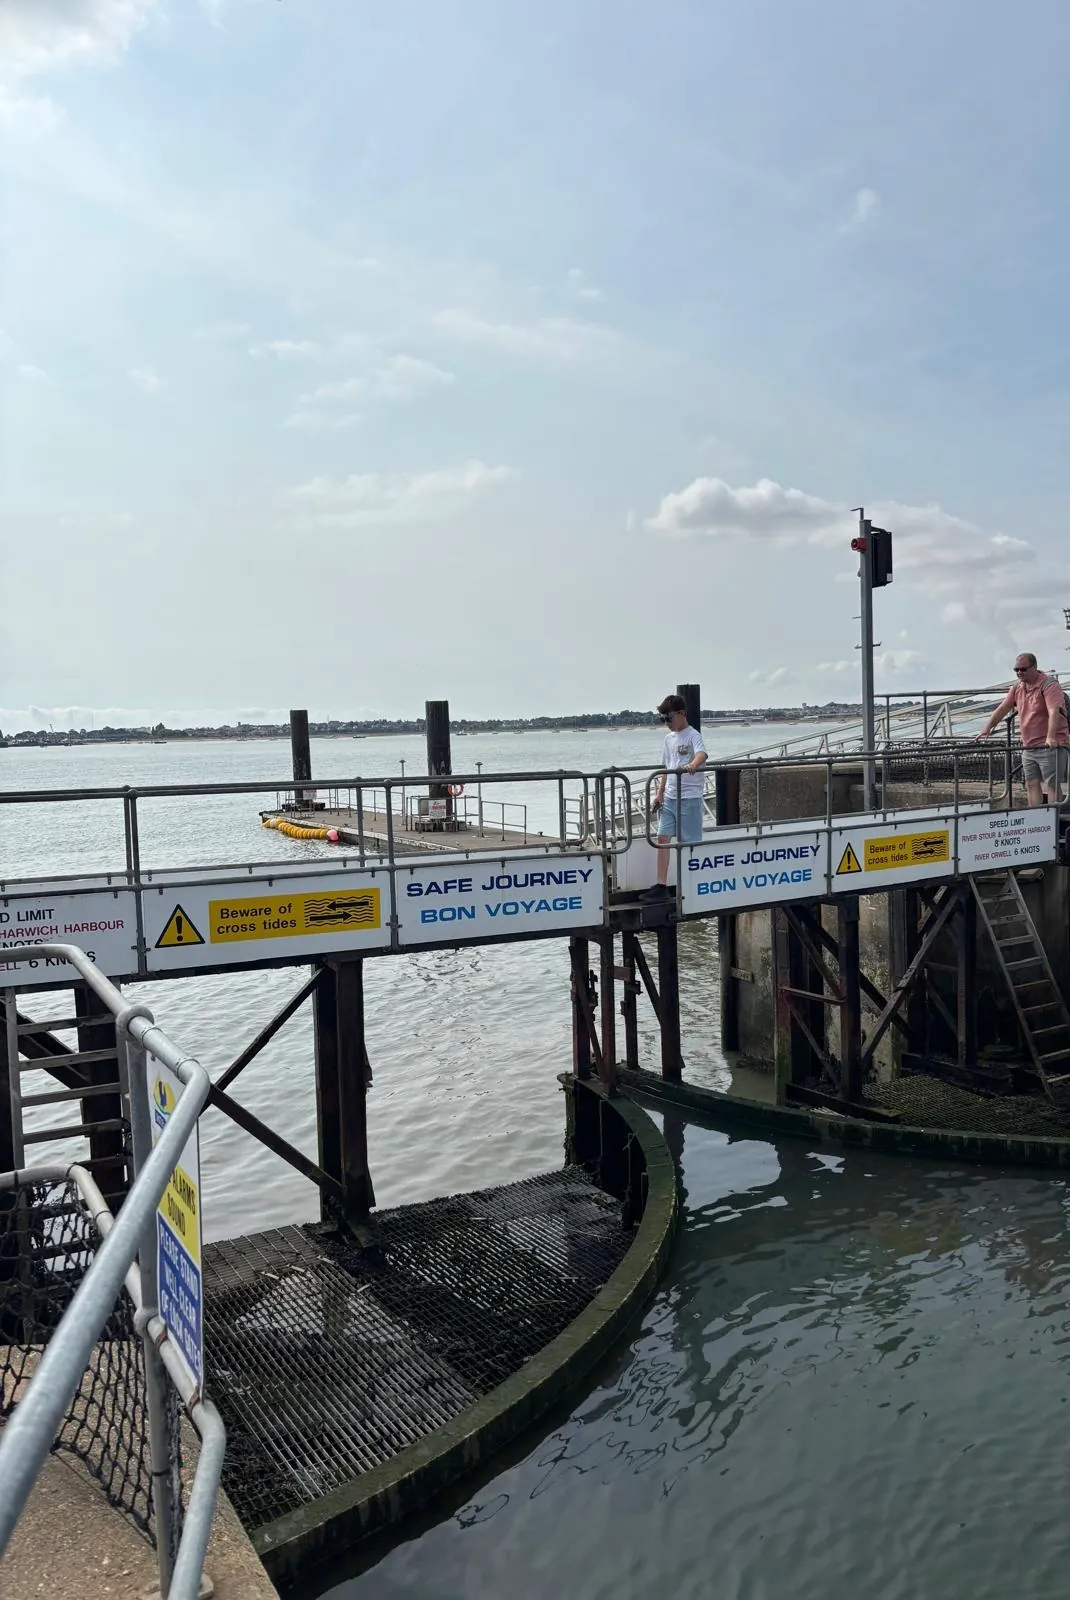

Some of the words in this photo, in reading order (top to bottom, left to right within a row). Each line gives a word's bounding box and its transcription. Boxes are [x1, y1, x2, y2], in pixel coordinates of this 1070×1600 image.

[989, 820, 1008, 829] SPEED
[1010, 818, 1025, 827] LIMIT
[962, 834, 979, 843] RIVER
[979, 831, 996, 840] STOUR
[1003, 828, 1027, 837] HARWICH
[1027, 825, 1051, 834] HARBOUR
[994, 840, 999, 848] 8
[1000, 837, 1021, 847] KNOTS
[869, 845, 896, 854] Beware
[898, 841, 906, 850] of
[974, 853, 990, 862] RIVER
[991, 850, 1012, 859] ORWELL
[1014, 848, 1019, 856] 6
[1020, 845, 1040, 855] KNOTS
[688, 854, 735, 871] SAFE
[741, 845, 821, 865] JOURNEY
[868, 857, 889, 865] cross
[891, 852, 909, 862] tides
[406, 878, 473, 897] SAFE
[481, 868, 594, 891] JOURNEY
[697, 881, 736, 896] BON
[743, 869, 812, 889] VOYAGE
[17, 908, 55, 922] LIMIT
[220, 906, 272, 919] Beware
[278, 902, 293, 914] of
[421, 905, 476, 924] BON
[485, 896, 583, 917] VOYAGE
[0, 925, 59, 939] HARWICH
[64, 919, 125, 934] HARBOUR
[217, 923, 257, 935] cross
[263, 918, 297, 930] tides
[0, 938, 44, 949] NOTS
[45, 951, 96, 967] KNS
[167, 1191, 186, 1237] SOUND
[160, 1223, 180, 1272] PLEASE
[180, 1253, 199, 1301] STAND
[161, 1288, 169, 1313] OF
[163, 1259, 180, 1303] WELL
[179, 1285, 197, 1335] CLEAR
